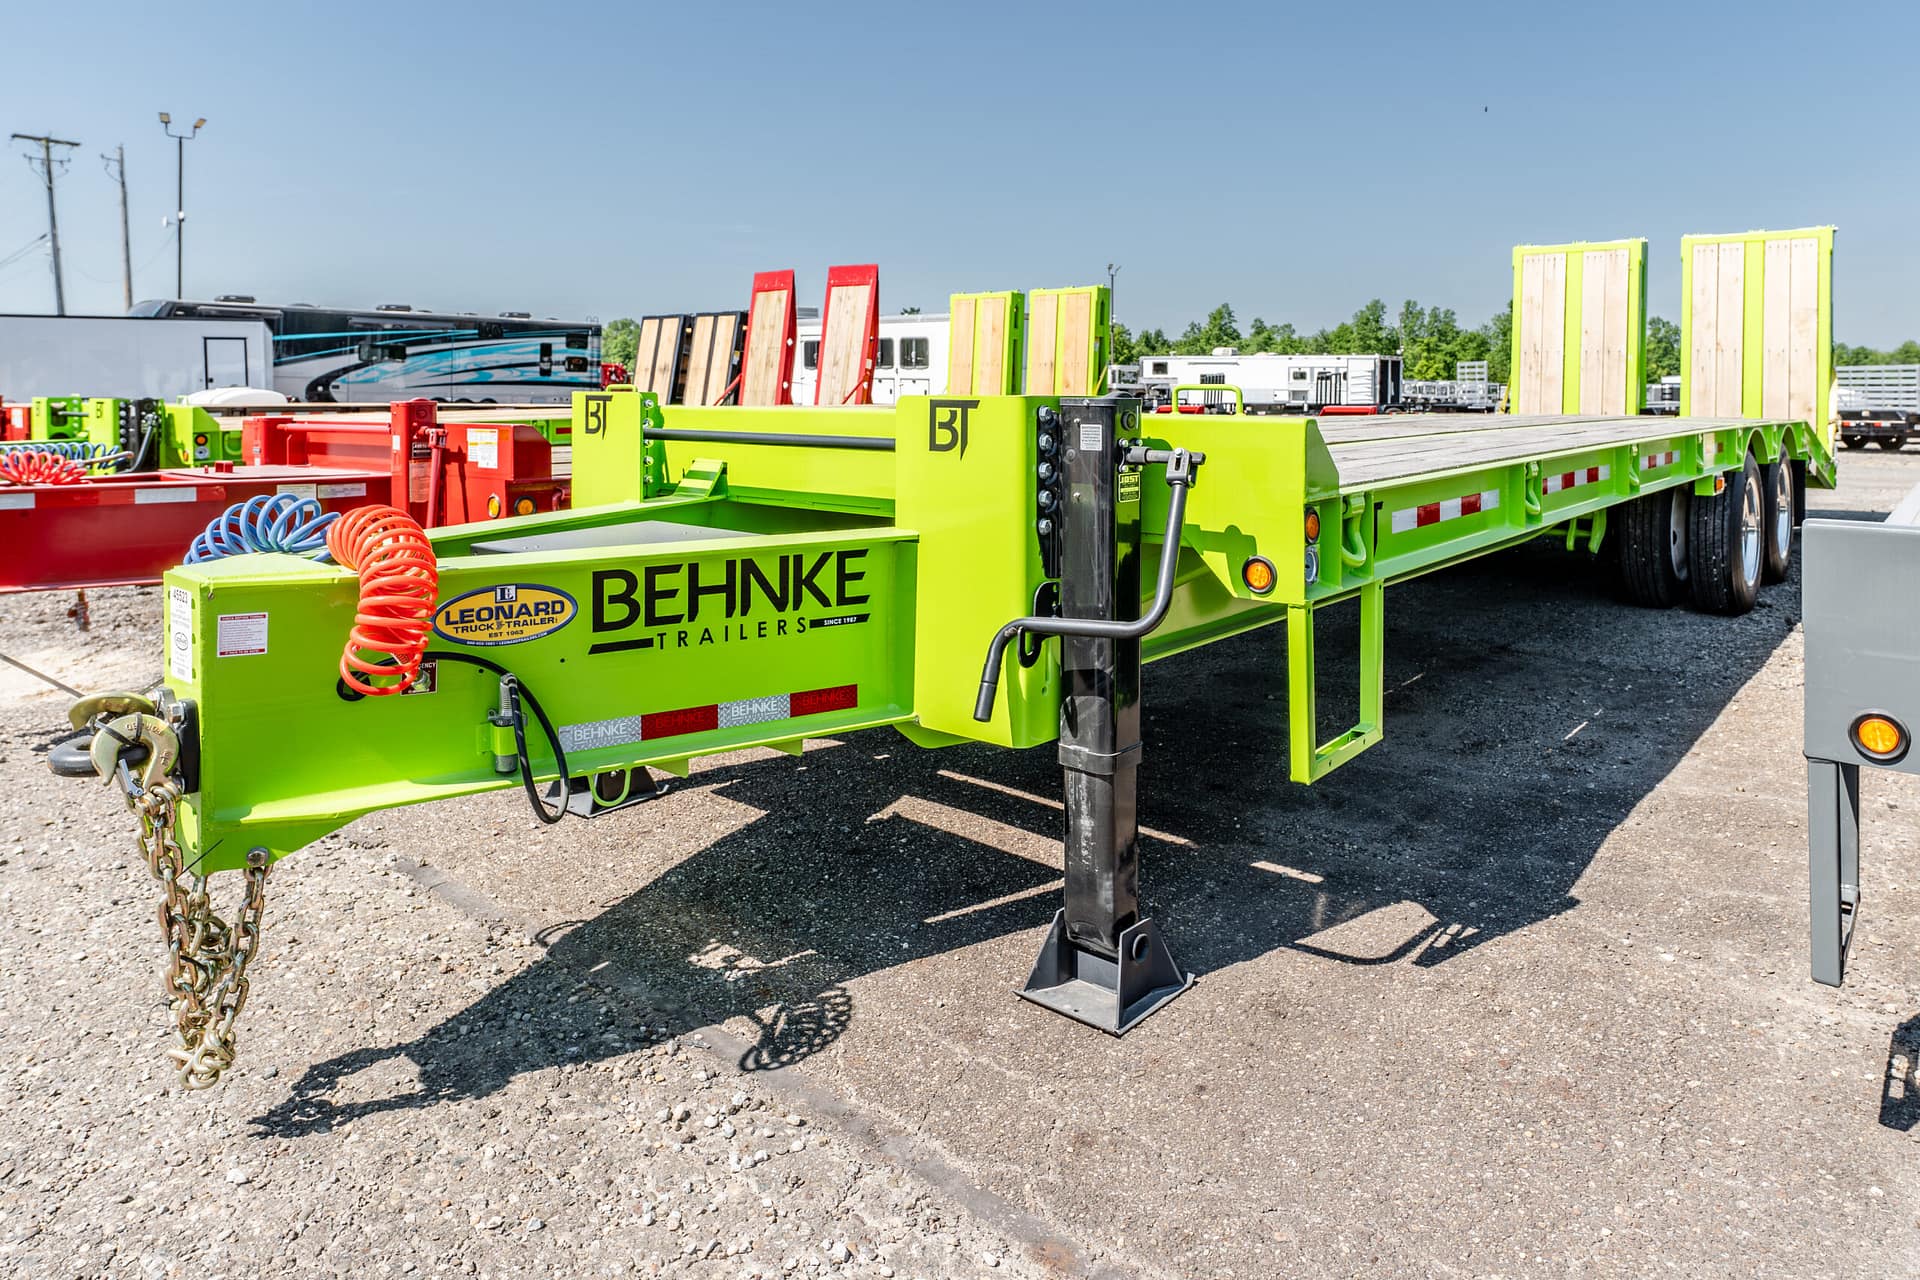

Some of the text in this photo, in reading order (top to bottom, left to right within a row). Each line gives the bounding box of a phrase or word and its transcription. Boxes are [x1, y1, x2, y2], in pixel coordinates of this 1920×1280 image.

[585, 395, 613, 440] BT
[929, 399, 980, 461] BT
[592, 549, 871, 633] BEHNKE
[445, 600, 565, 626] LEONARD
[823, 616, 857, 626] SINCE 1987
[453, 622, 495, 634] TRUCK
[505, 616, 555, 629] TRAILER
[657, 617, 806, 650] TRAILERS
[802, 690, 846, 706] BEHNKE
[731, 700, 778, 718] BEHNKE
[655, 711, 705, 728] BEHNKE
[574, 722, 628, 742] BEHNKE
